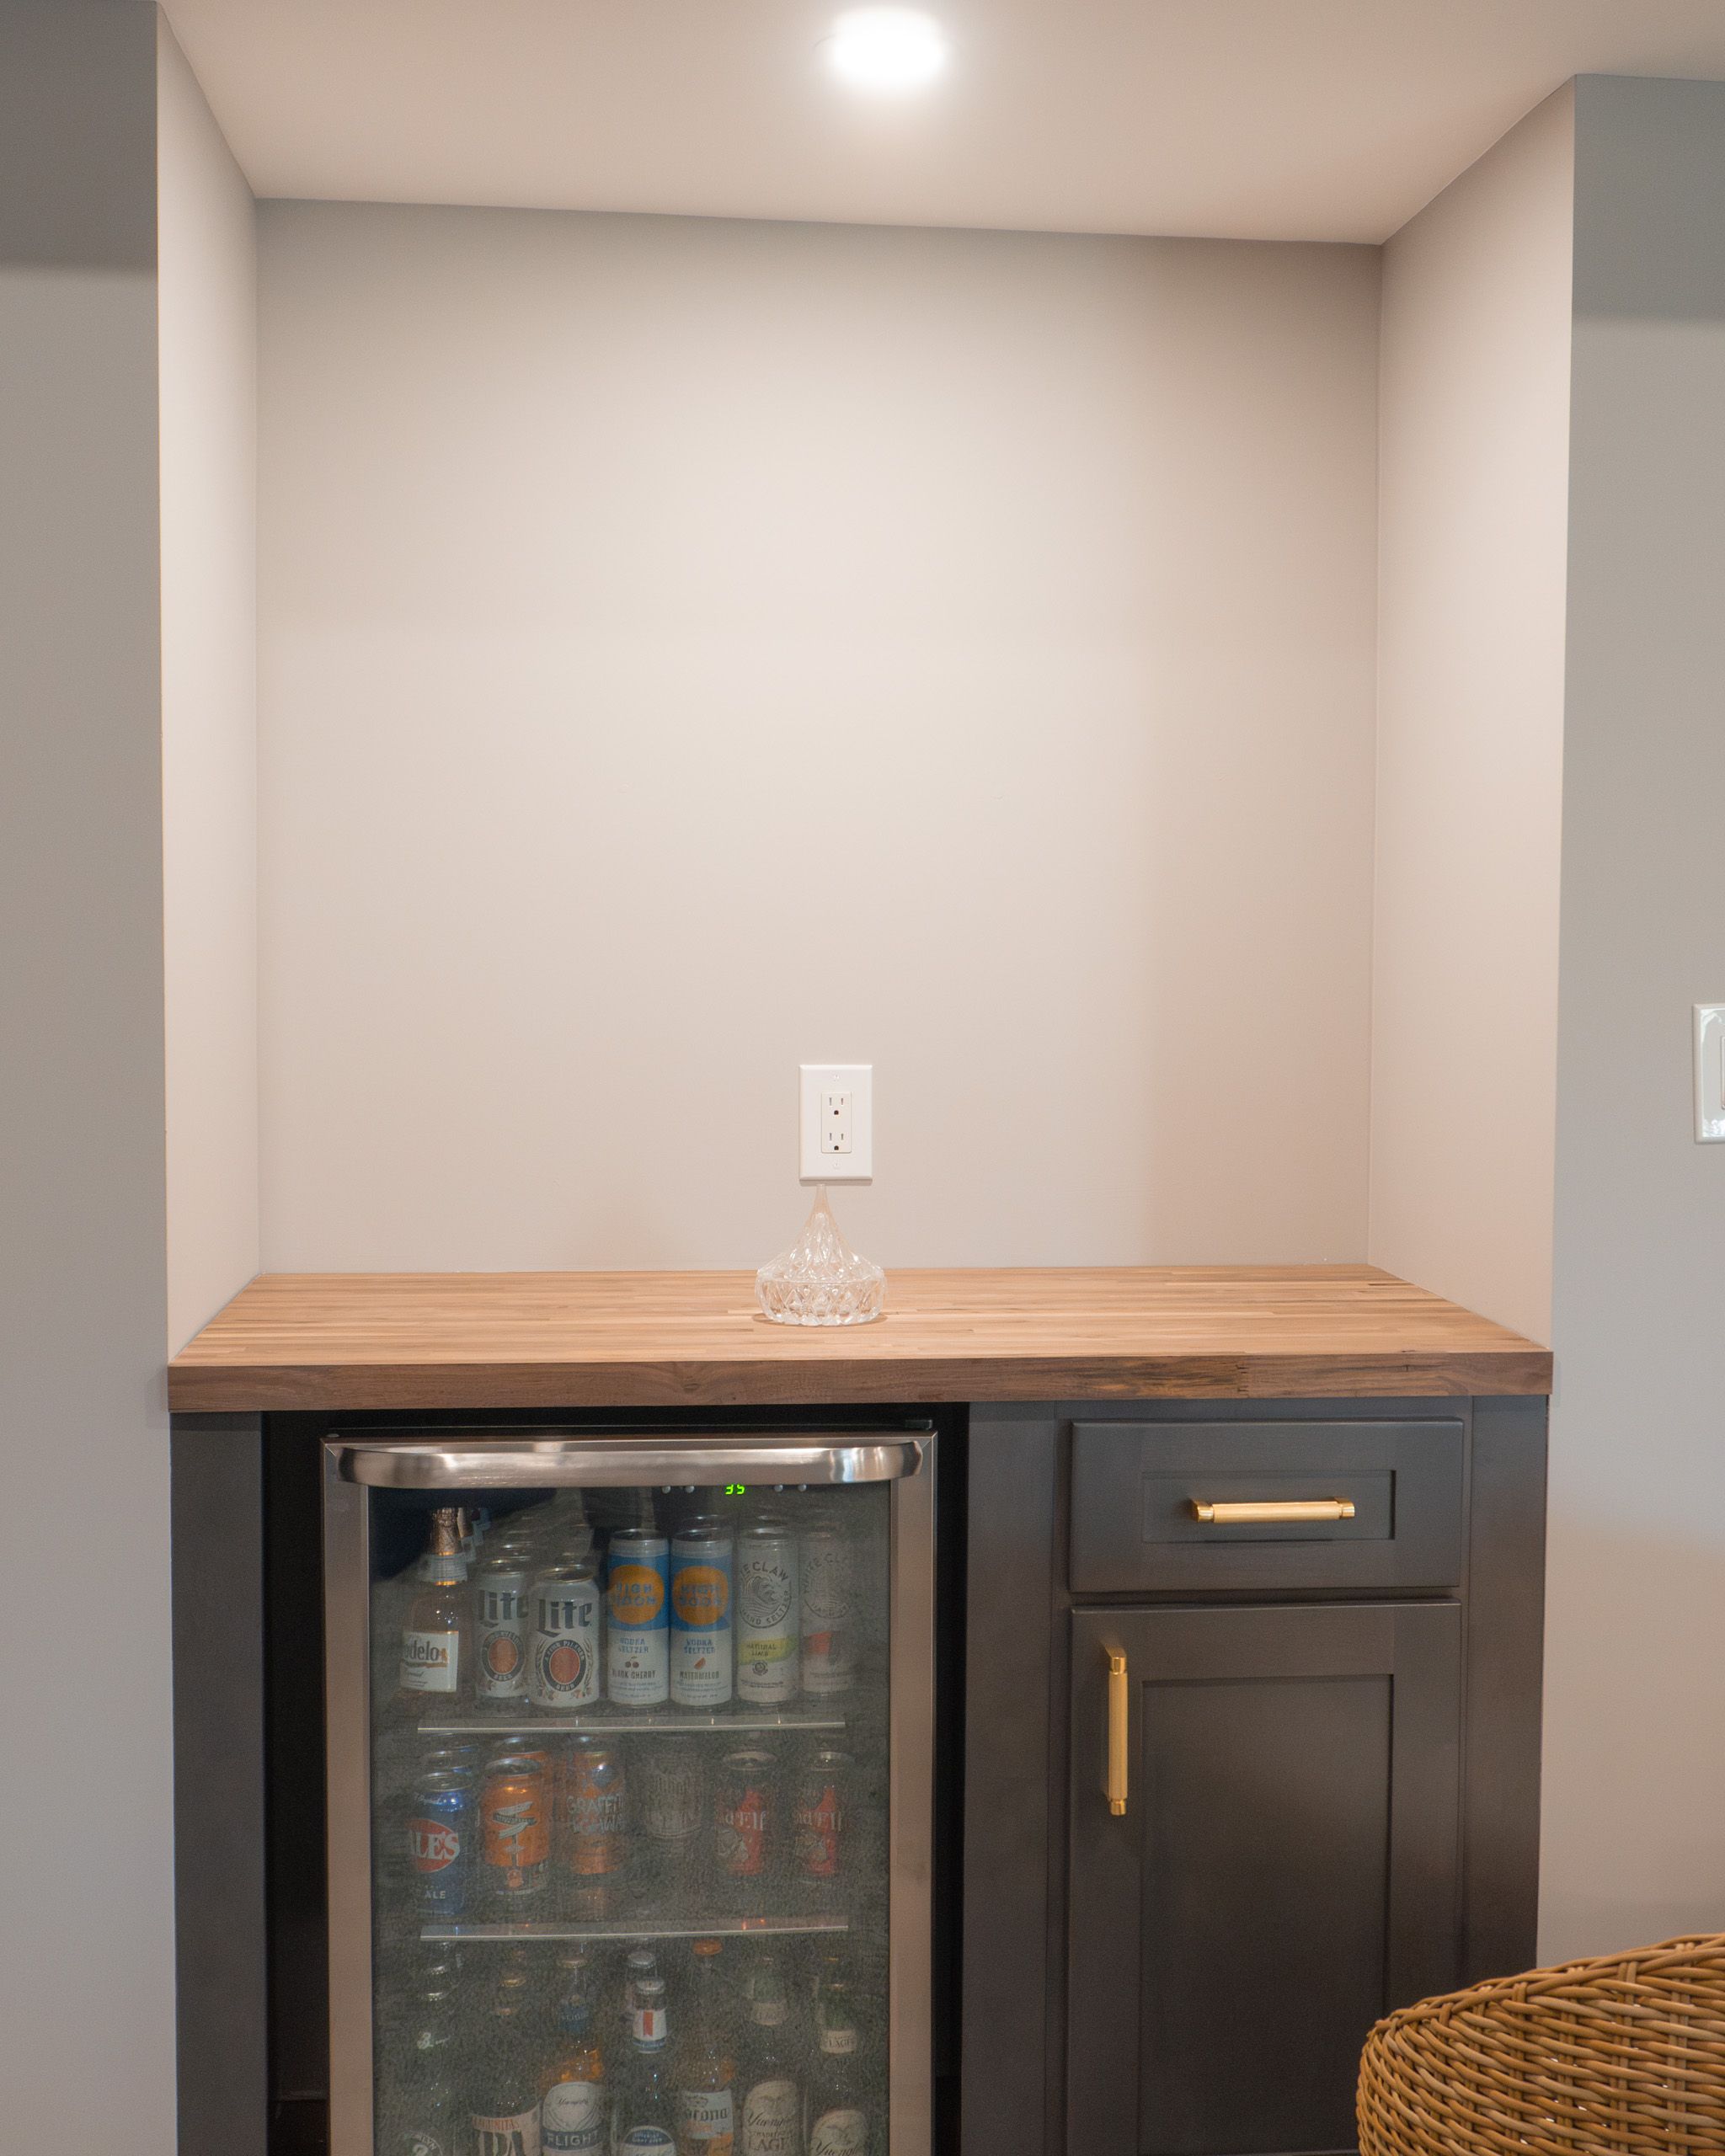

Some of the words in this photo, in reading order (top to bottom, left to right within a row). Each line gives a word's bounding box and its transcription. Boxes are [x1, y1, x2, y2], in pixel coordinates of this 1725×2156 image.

[725, 1484, 745, 1495] 35
[752, 1561, 789, 1582] CLAW
[535, 1598, 593, 1638] Lite
[403, 1639, 440, 1662] odelo
[546, 2131, 599, 2148] FLIGHT
